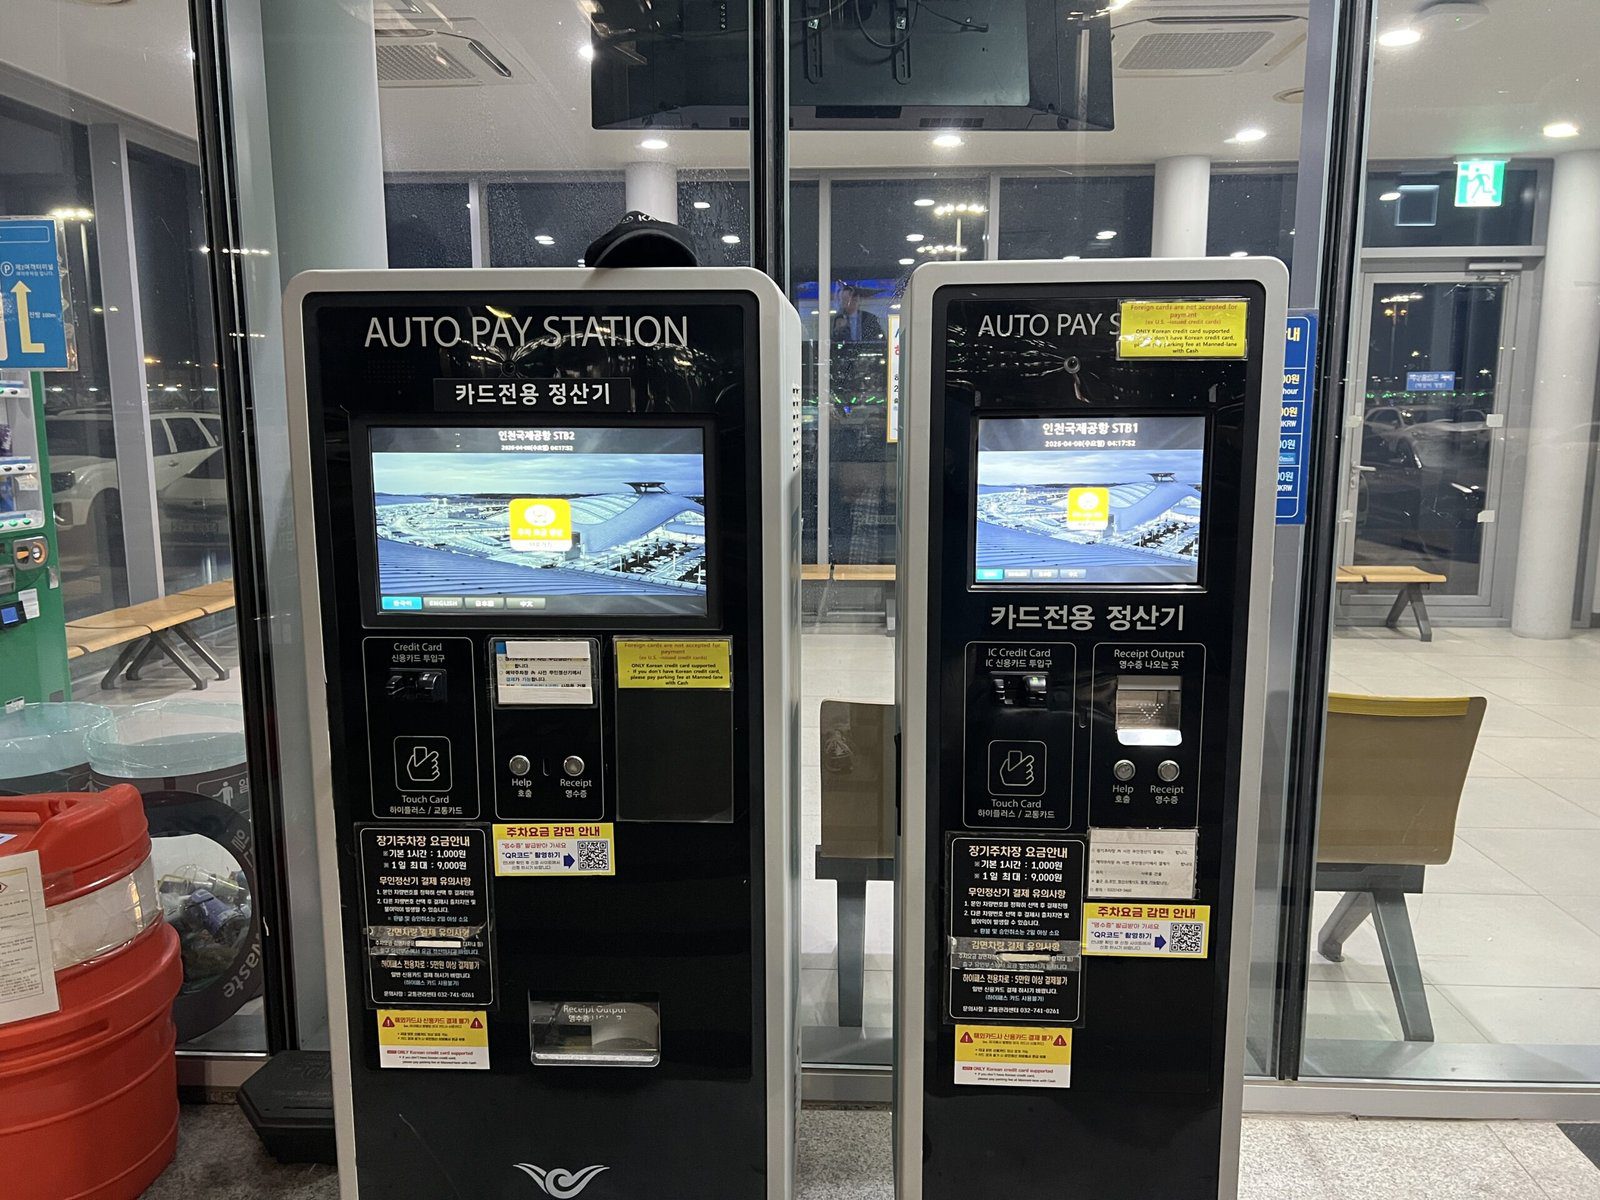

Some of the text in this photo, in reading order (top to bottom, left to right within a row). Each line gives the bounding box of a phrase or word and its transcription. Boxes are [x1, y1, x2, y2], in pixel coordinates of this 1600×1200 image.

[978, 314, 1049, 337] AUTO
[1057, 313, 1102, 336] PAY
[364, 315, 688, 347] AUTO PAY STATION
[455, 382, 611, 406] 카드전용 정산기
[1042, 422, 1138, 436] 인천국제공항 STB1
[498, 430, 575, 442] 인천국제공항 STB2
[990, 604, 1184, 631] 카드전용 정산기
[393, 642, 443, 652] Credit Card
[988, 648, 1051, 657] IC Credit Card
[1114, 649, 1185, 660] Receipt Output
[391, 654, 422, 662] 신용카드
[985, 659, 1053, 668] IC 신용카드 투입구
[1119, 660, 1179, 669] 영수증 나오는 곳
[511, 779, 592, 788] Help Receipt
[517, 789, 587, 798] 호출 영수증
[1112, 785, 1184, 795] Help Receipt
[401, 795, 449, 803] Touch Card
[991, 799, 1042, 808] Touch Card
[1114, 795, 1179, 804] 호출 영수증
[389, 806, 463, 815] 하이플러스 교통카드
[977, 809, 1055, 819] 하이플러스 교통카드
[506, 826, 600, 838] 주차요금 감면 안내
[376, 835, 470, 847] 장기주차장 요금안내
[407, 849, 427, 858] 1시간
[436, 850, 466, 859] 1,000원
[534, 851, 560, 859] 촬영하기
[968, 845, 1068, 859] 장기주차장 요금안내
[437, 862, 467, 870] 9,000원
[1000, 860, 1021, 870] 1시간
[1031, 861, 1063, 871] 1,000원
[379, 876, 419, 886] 무인정산기
[440, 877, 471, 886] 유의사항
[1031, 873, 1063, 882] 9,000원
[968, 887, 1066, 899] 무인정산기 결제 유의사항
[1098, 906, 1196, 919] 주차요금 감면 안내
[1091, 931, 1123, 939] "QR코드"
[1007, 941, 1025, 951] 결제
[563, 1004, 595, 1014] Receipt
